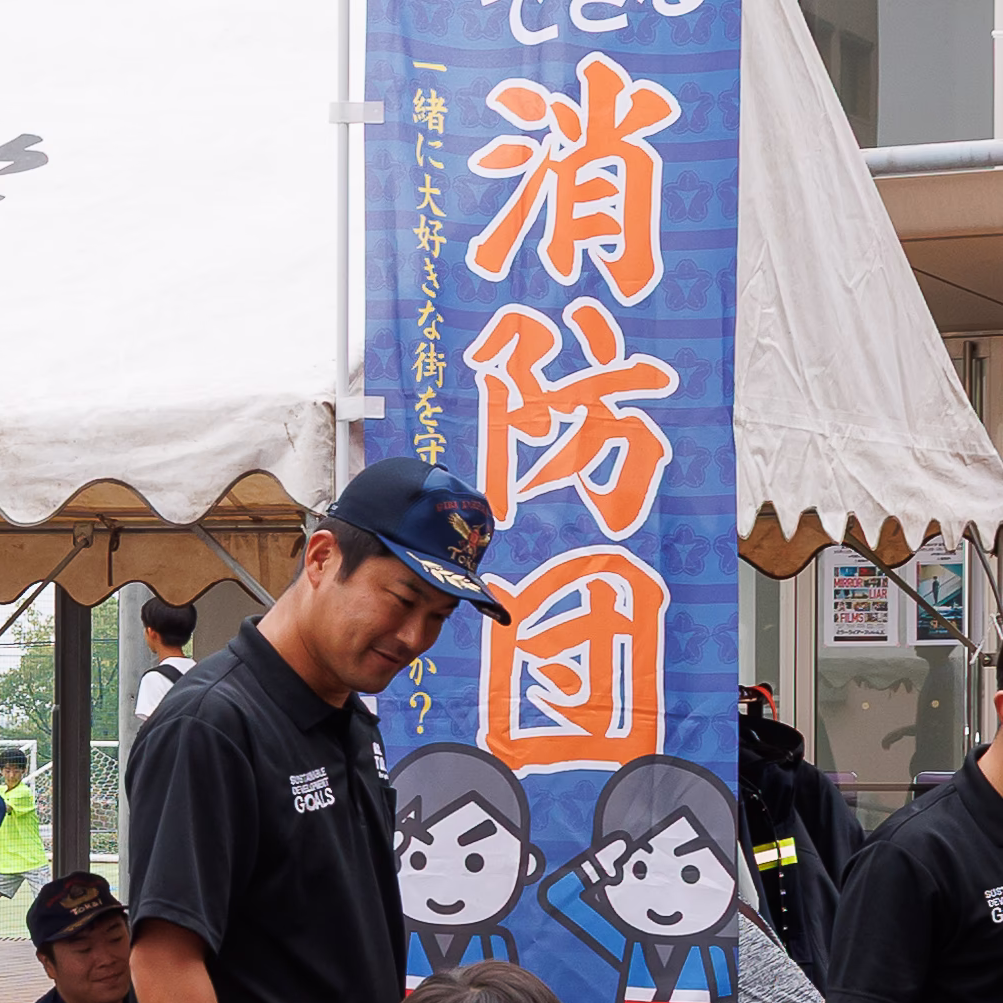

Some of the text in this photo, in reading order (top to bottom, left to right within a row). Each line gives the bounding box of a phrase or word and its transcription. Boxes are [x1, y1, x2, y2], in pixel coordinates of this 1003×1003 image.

[465, 51, 681, 780] 消防団
[834, 577, 864, 588] MIRROR
[869, 588, 888, 599] LIAR
[840, 612, 865, 623] FILMS
[294, 787, 336, 814] GOALS
